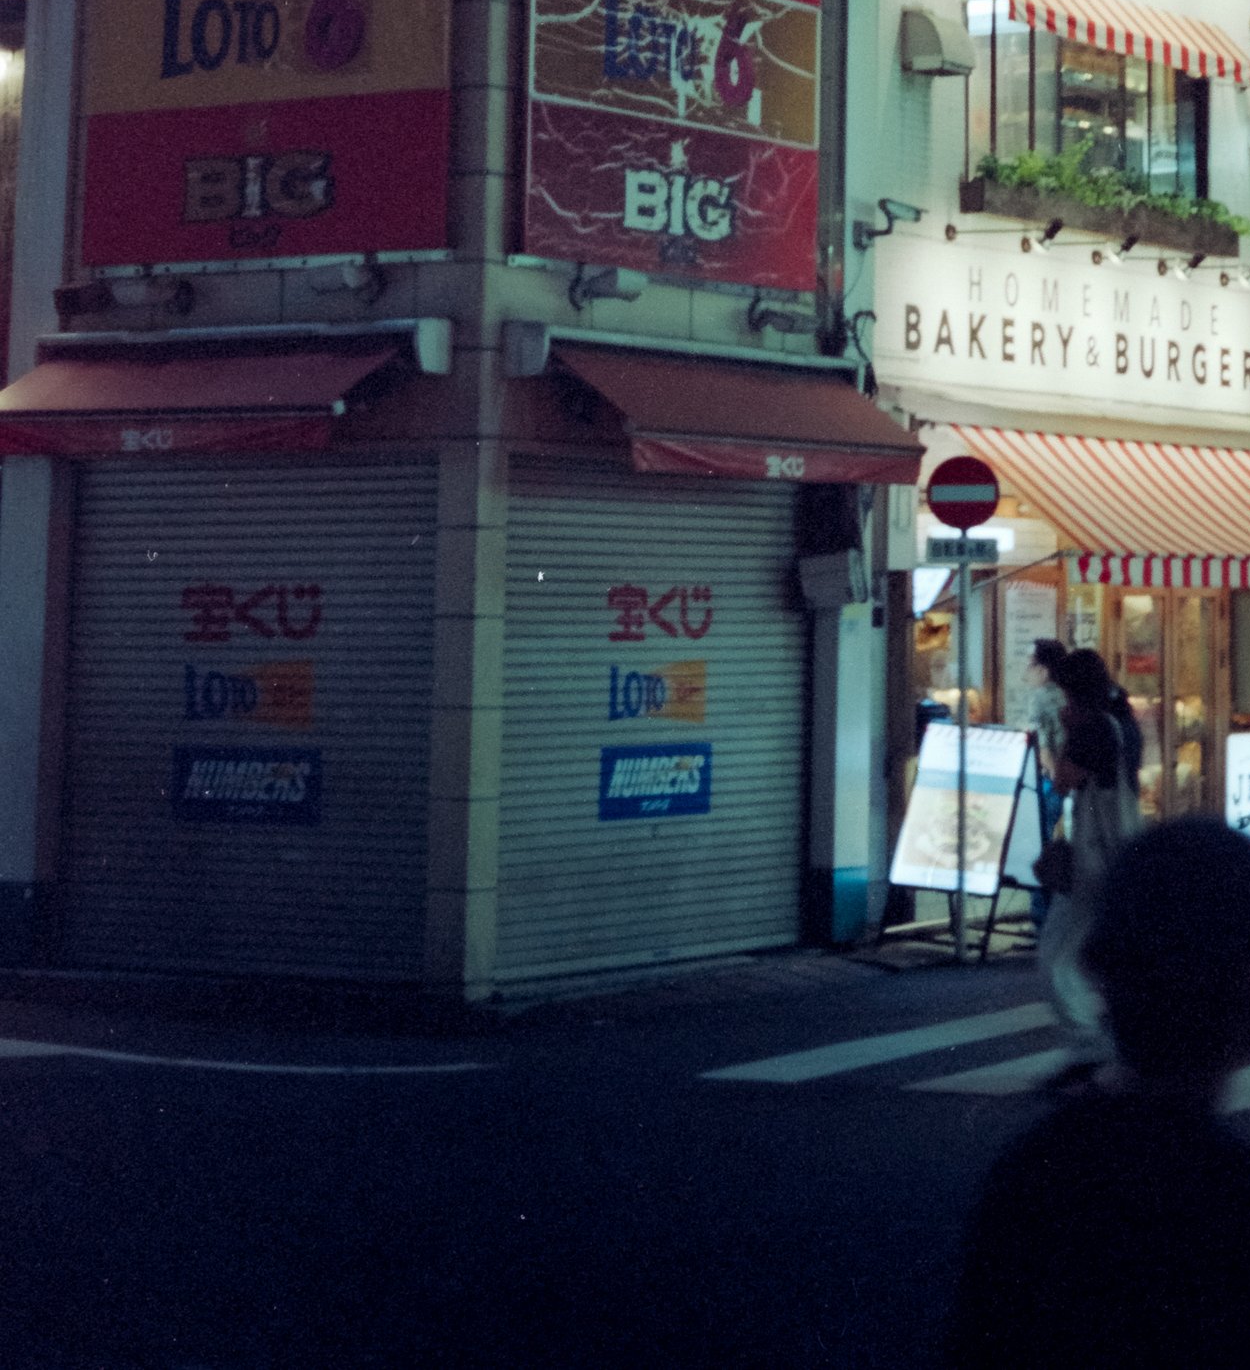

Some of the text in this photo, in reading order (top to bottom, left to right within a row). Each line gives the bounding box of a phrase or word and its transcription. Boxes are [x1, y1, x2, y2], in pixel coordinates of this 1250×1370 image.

[184, 151, 334, 223] BIG
[625, 168, 732, 241] BIG
[968, 266, 1220, 337] HOMEMADE
[905, 304, 1074, 368] BAKERY
[1086, 335, 1100, 368] &
[182, 585, 322, 642] 宝くじ
[608, 584, 713, 641] 宝くじ
[183, 759, 310, 802] NUMBERS
[607, 755, 705, 798] NUMBERS
